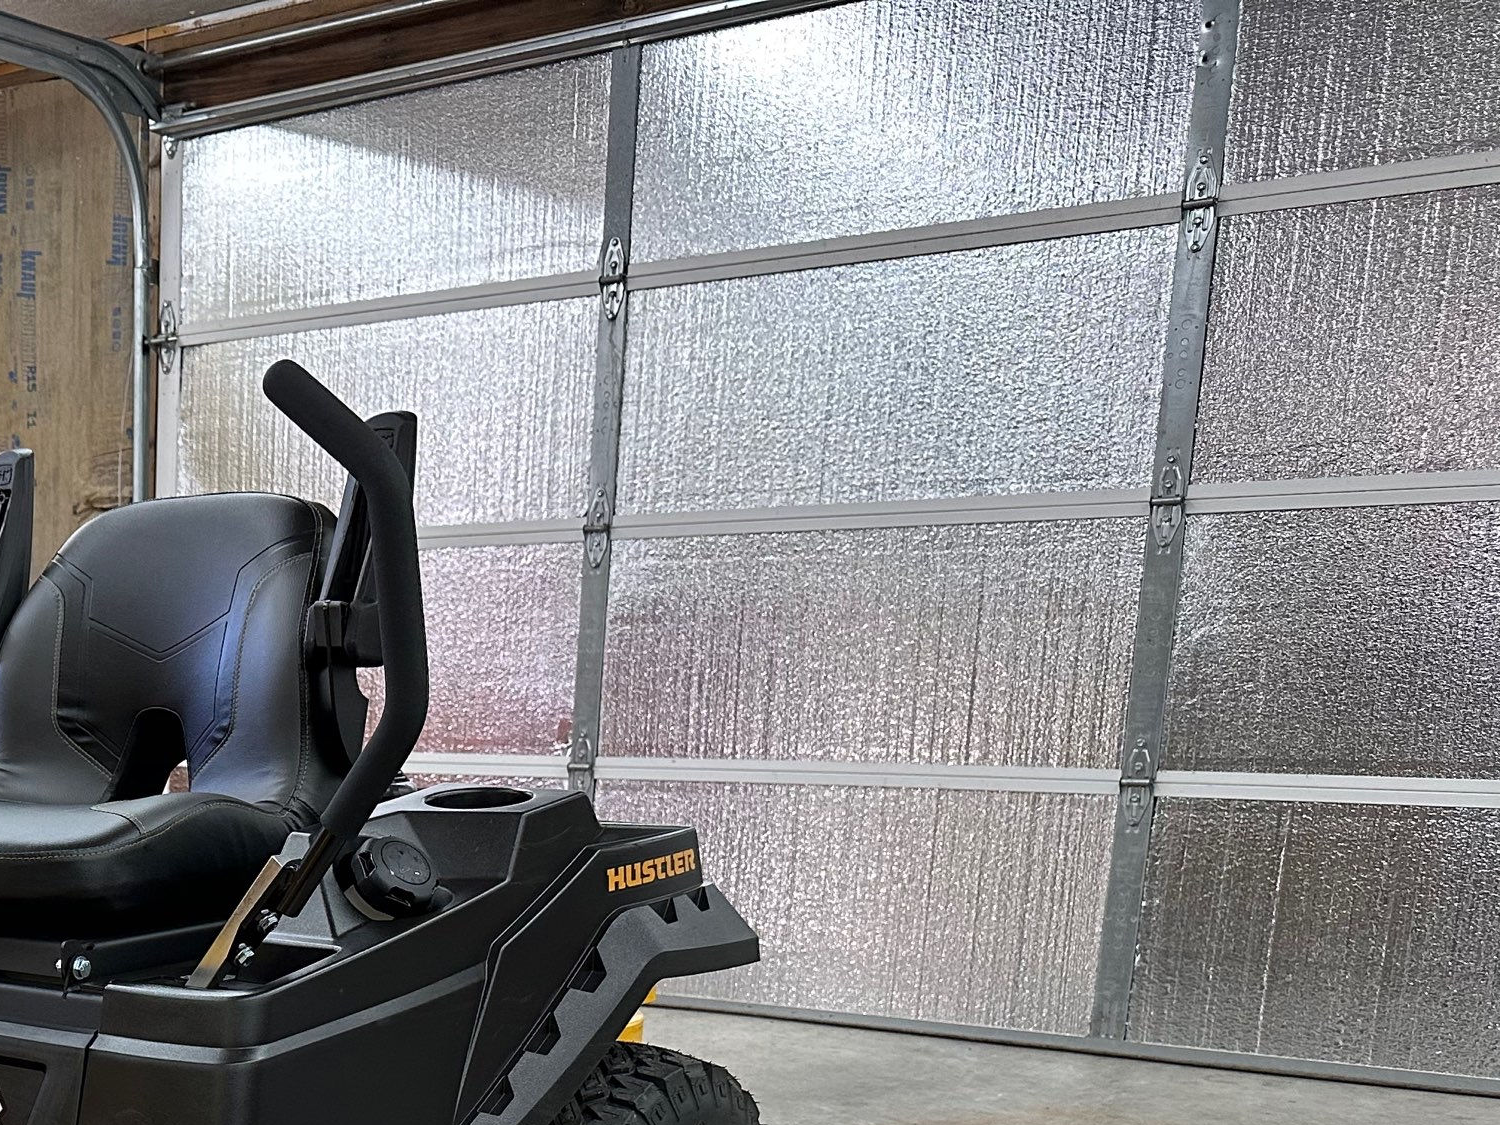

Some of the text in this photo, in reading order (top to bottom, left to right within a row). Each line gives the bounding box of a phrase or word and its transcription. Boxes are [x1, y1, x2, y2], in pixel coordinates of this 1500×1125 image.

[106, 213, 134, 267] KNAUF
[17, 250, 43, 300] KNAUF
[26, 365, 37, 393] R15
[607, 848, 695, 892] HUSTLER
